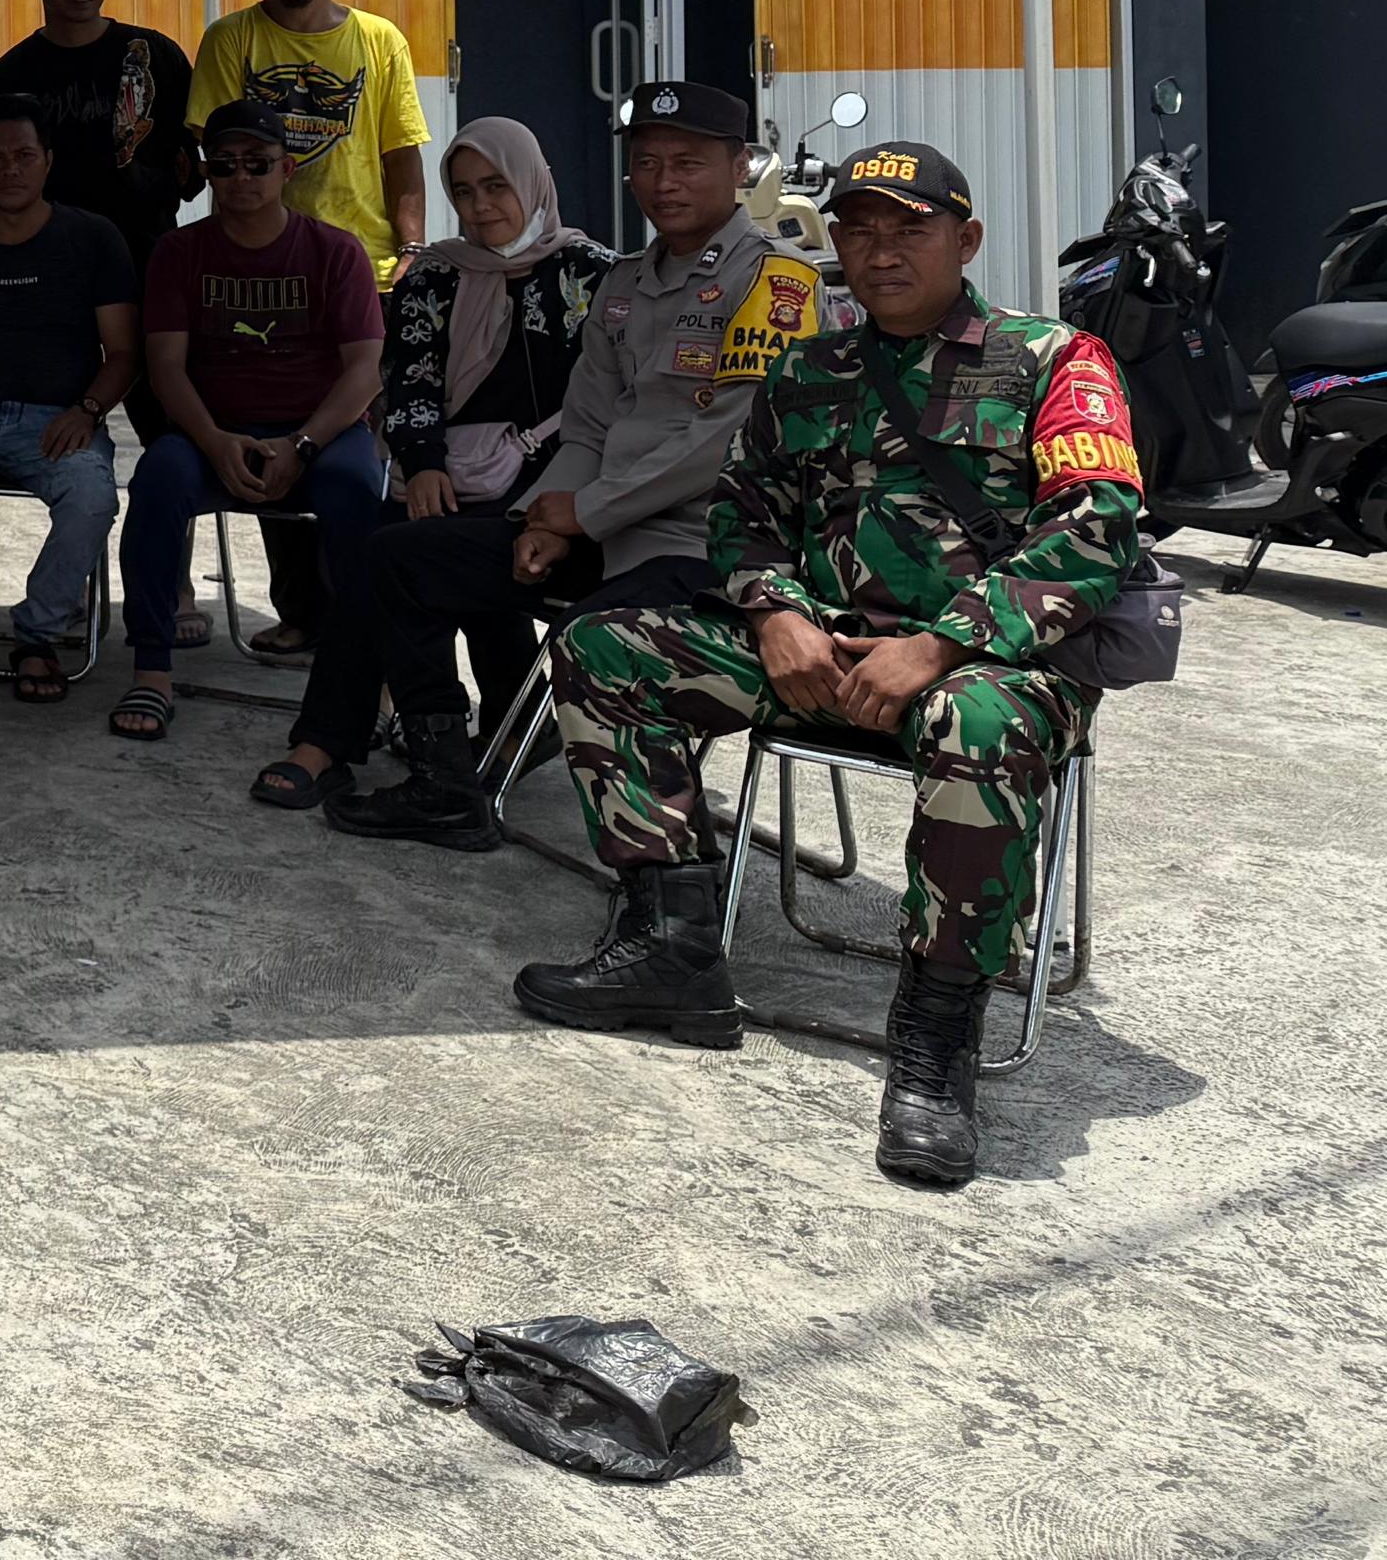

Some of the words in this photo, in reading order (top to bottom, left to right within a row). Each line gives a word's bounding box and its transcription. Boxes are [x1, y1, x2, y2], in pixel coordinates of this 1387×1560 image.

[851, 159, 917, 181] 0908
[202, 274, 308, 312] PUMA
[733, 326, 794, 352] BHA
[719, 351, 776, 372] KAMT
